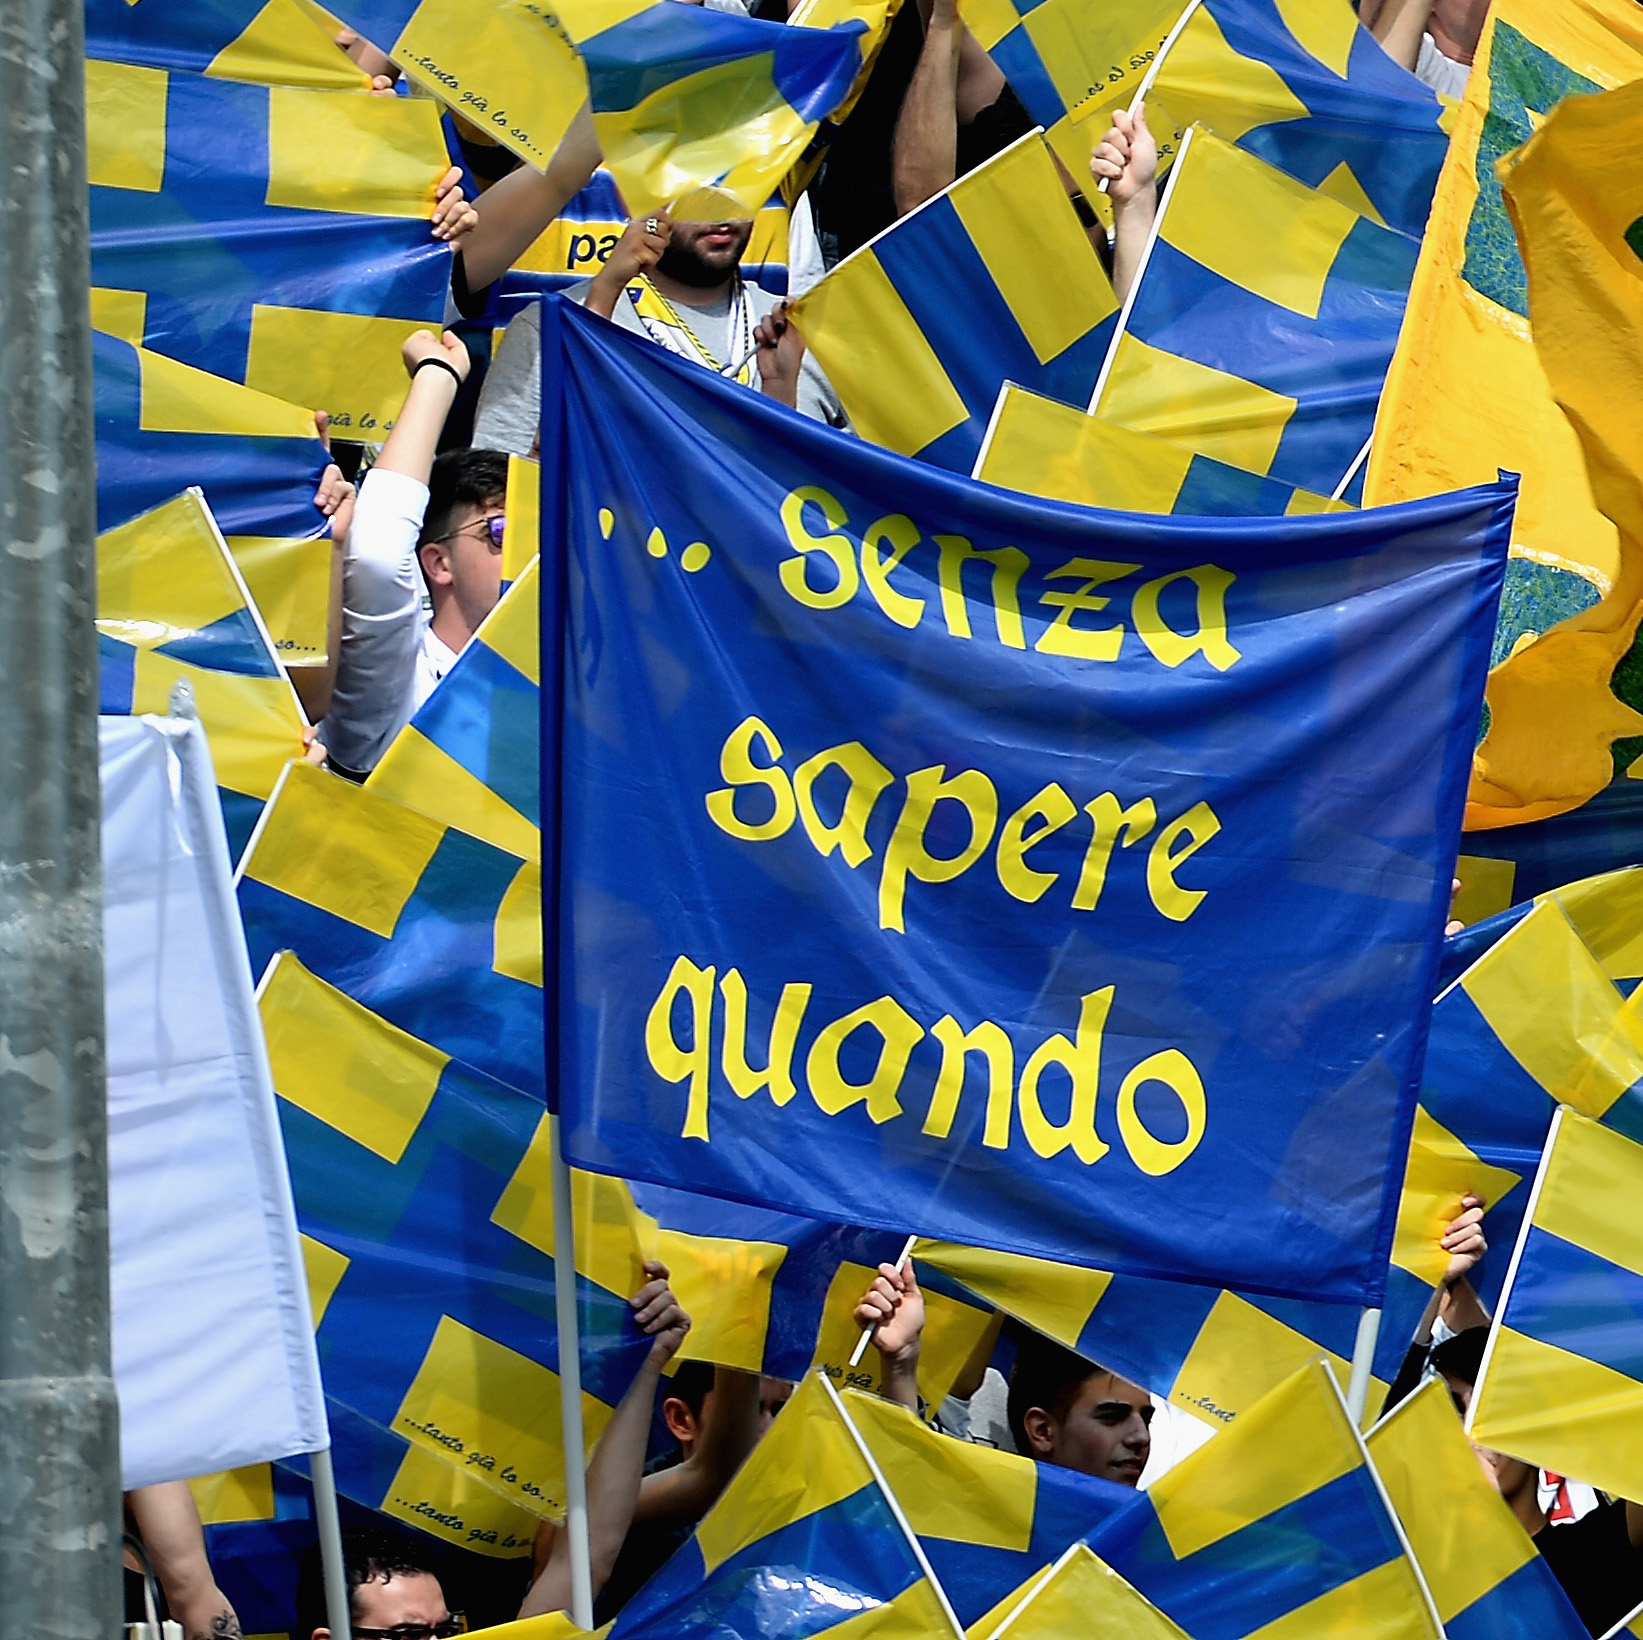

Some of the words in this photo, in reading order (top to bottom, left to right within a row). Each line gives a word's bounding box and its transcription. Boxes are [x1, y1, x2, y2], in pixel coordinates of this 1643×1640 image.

[401, 47, 460, 91] ...tanto
[459, 89, 488, 114] già
[491, 110, 508, 128] lo
[510, 125, 544, 157] so...
[779, 484, 1243, 674] senza
[705, 714, 1223, 936] sapere
[644, 953, 1209, 1178] quando
[403, 1417, 465, 1454] ...tanto
[464, 1451, 496, 1472] già
[498, 1465, 519, 1484] lo
[519, 1481, 560, 1508] so...
[1179, 1392, 1237, 1423] ...tant
[394, 1497, 465, 1531] ...tanto
[465, 1526, 499, 1543] già
